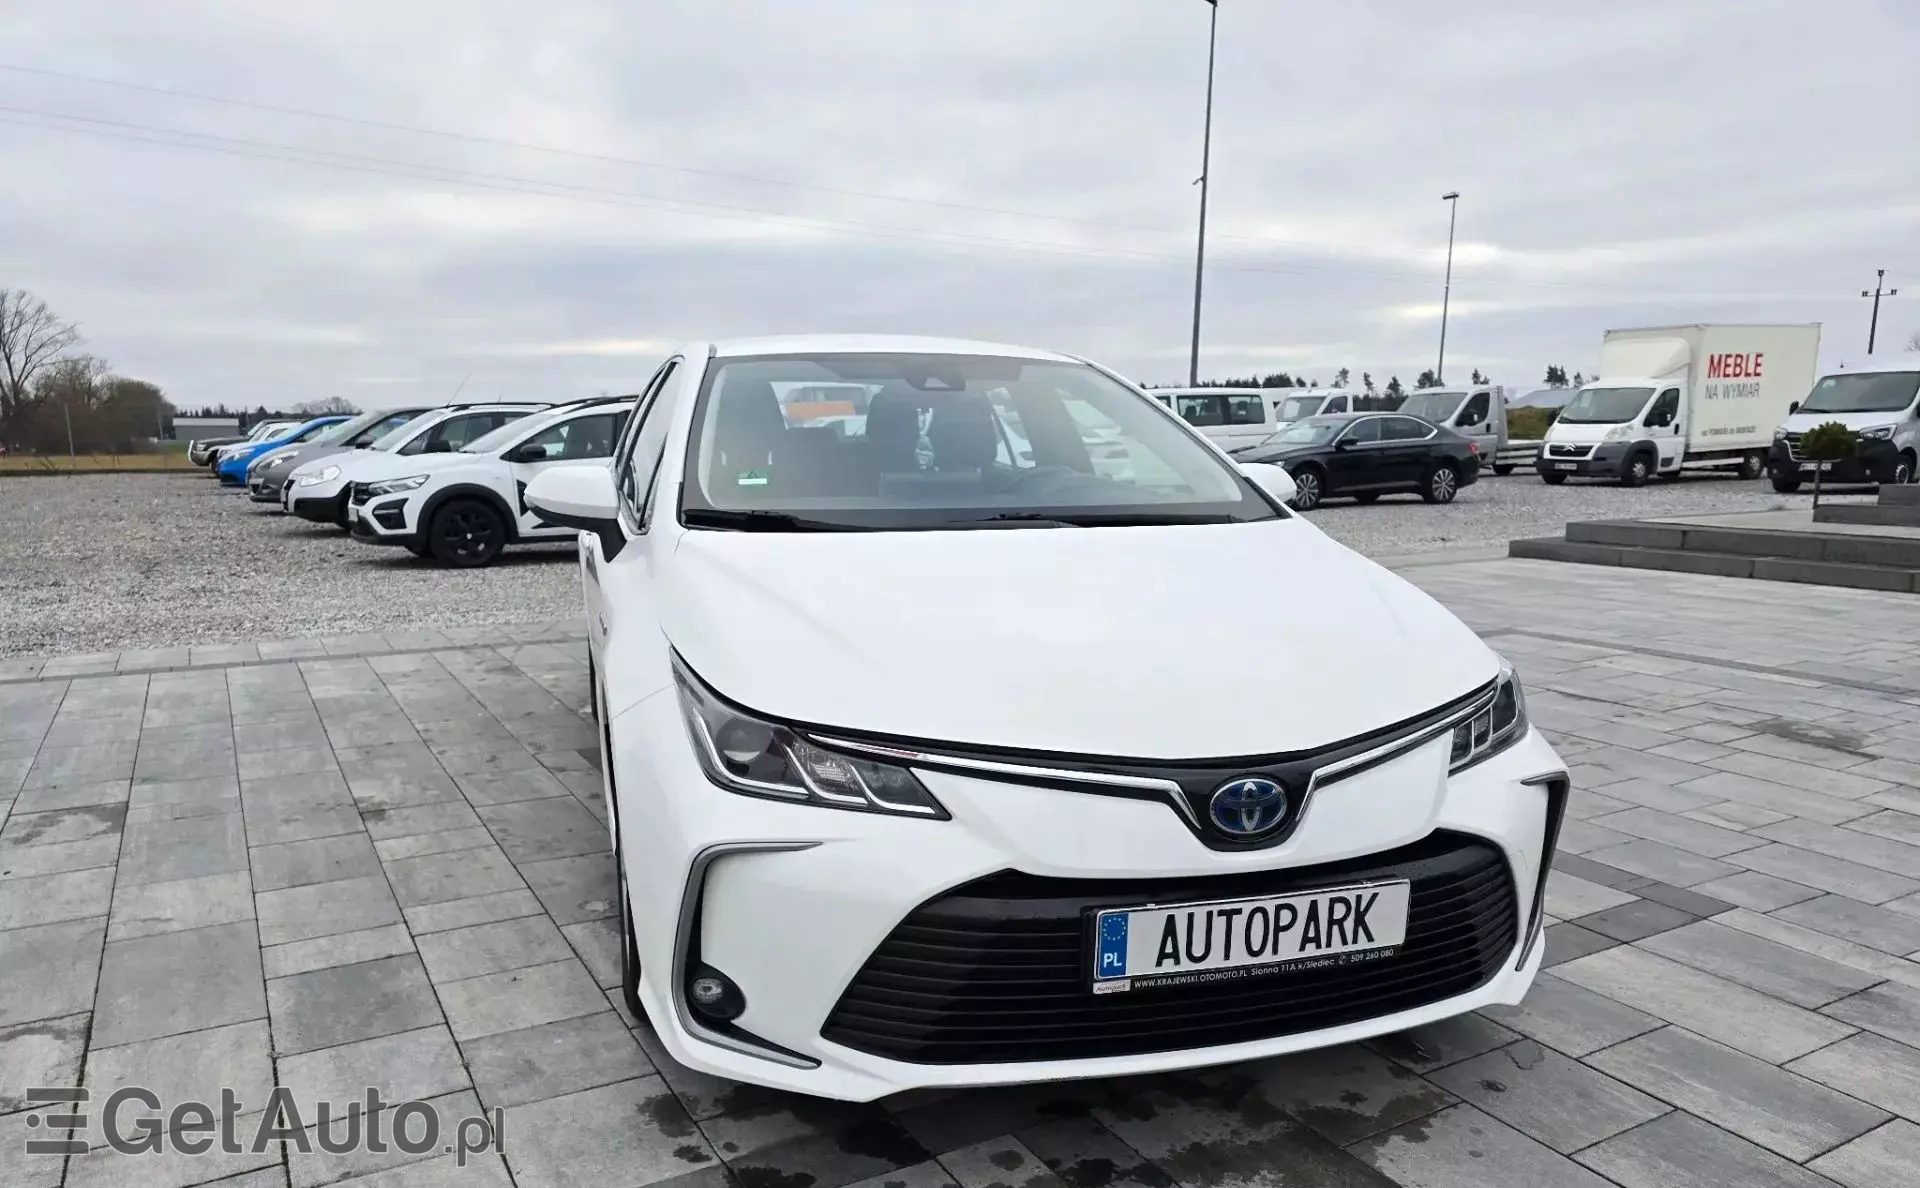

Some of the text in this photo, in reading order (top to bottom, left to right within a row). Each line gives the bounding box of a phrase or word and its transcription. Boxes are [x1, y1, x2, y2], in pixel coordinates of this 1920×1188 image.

[1707, 352, 1763, 378] MEBLE
[1705, 382, 1760, 399] NA WYMIAR
[1155, 892, 1379, 968] AUTOPARK
[1103, 952, 1123, 968] PL
[1134, 969, 1248, 988] WWW.KRAJEWSKI.OTOMOTO.PL
[1350, 953, 1364, 963] 509
